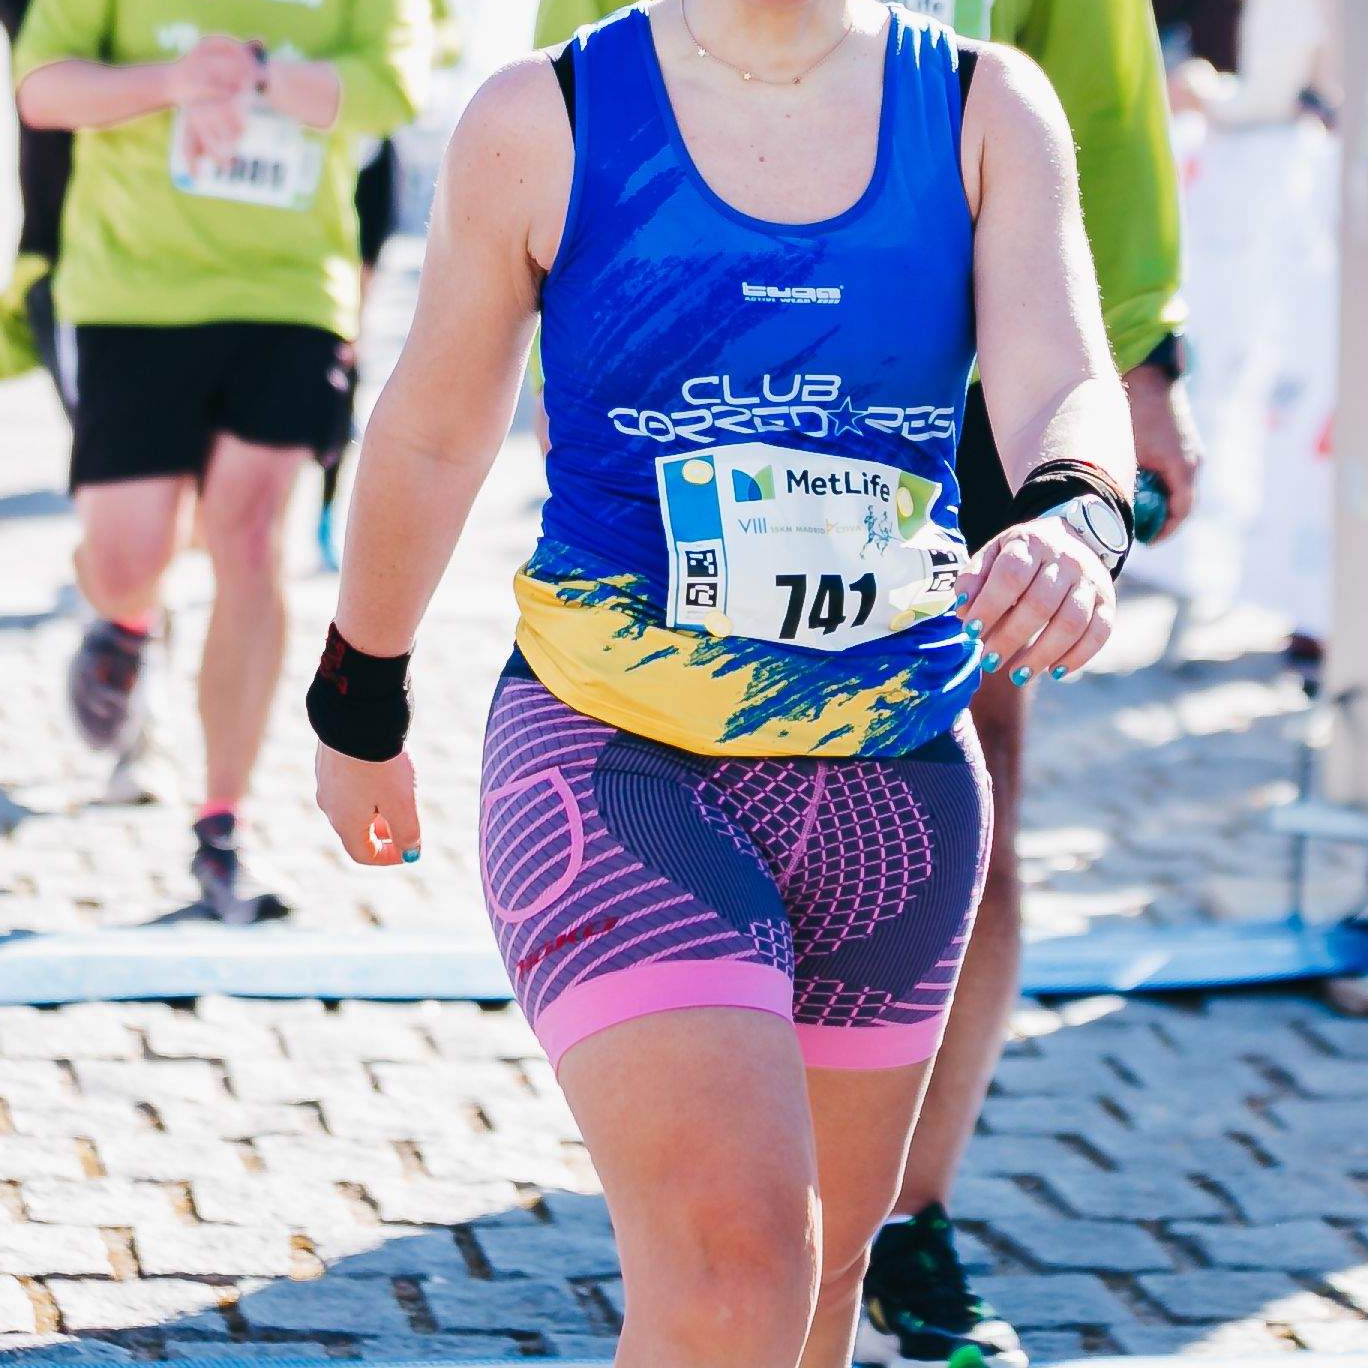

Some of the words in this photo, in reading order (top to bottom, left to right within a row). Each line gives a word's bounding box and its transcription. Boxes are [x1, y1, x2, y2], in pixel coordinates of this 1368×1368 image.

[682, 374, 842, 406] CLUB
[786, 469, 891, 503] MetLife
[737, 517, 768, 534] VIII
[774, 571, 878, 641] 741
